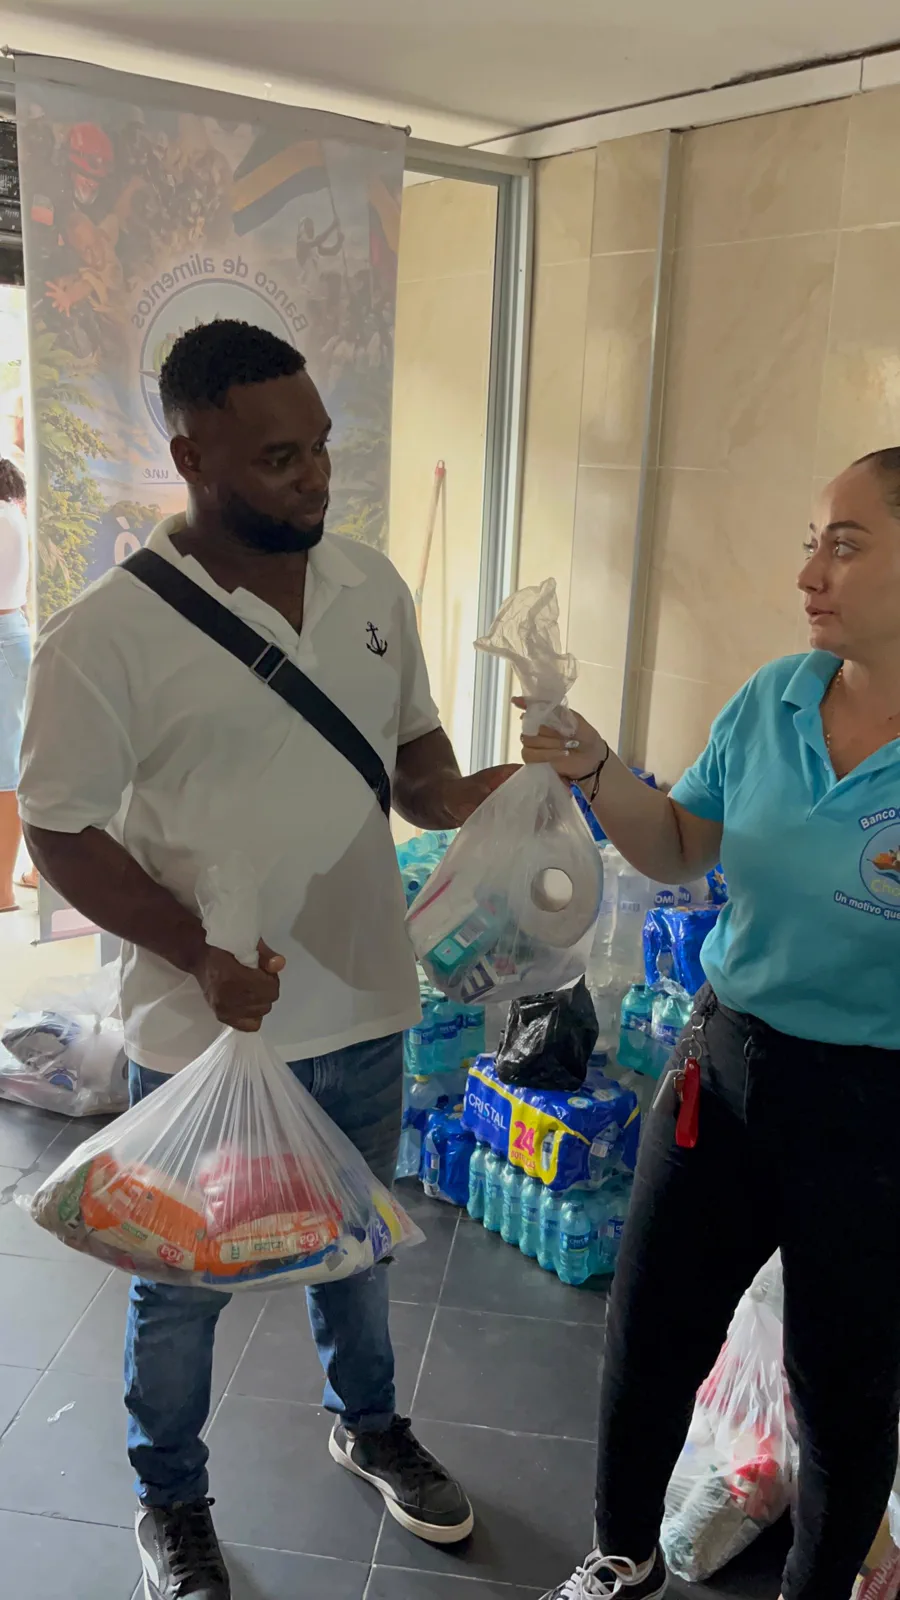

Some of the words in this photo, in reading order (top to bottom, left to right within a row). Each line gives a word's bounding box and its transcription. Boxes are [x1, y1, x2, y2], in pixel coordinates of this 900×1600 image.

[860, 809, 896, 829] Banco
[835, 891, 848, 904] Un
[848, 898, 882, 915] motivo
[468, 1093, 507, 1130] CRISTAL
[512, 1120, 536, 1156] 24
